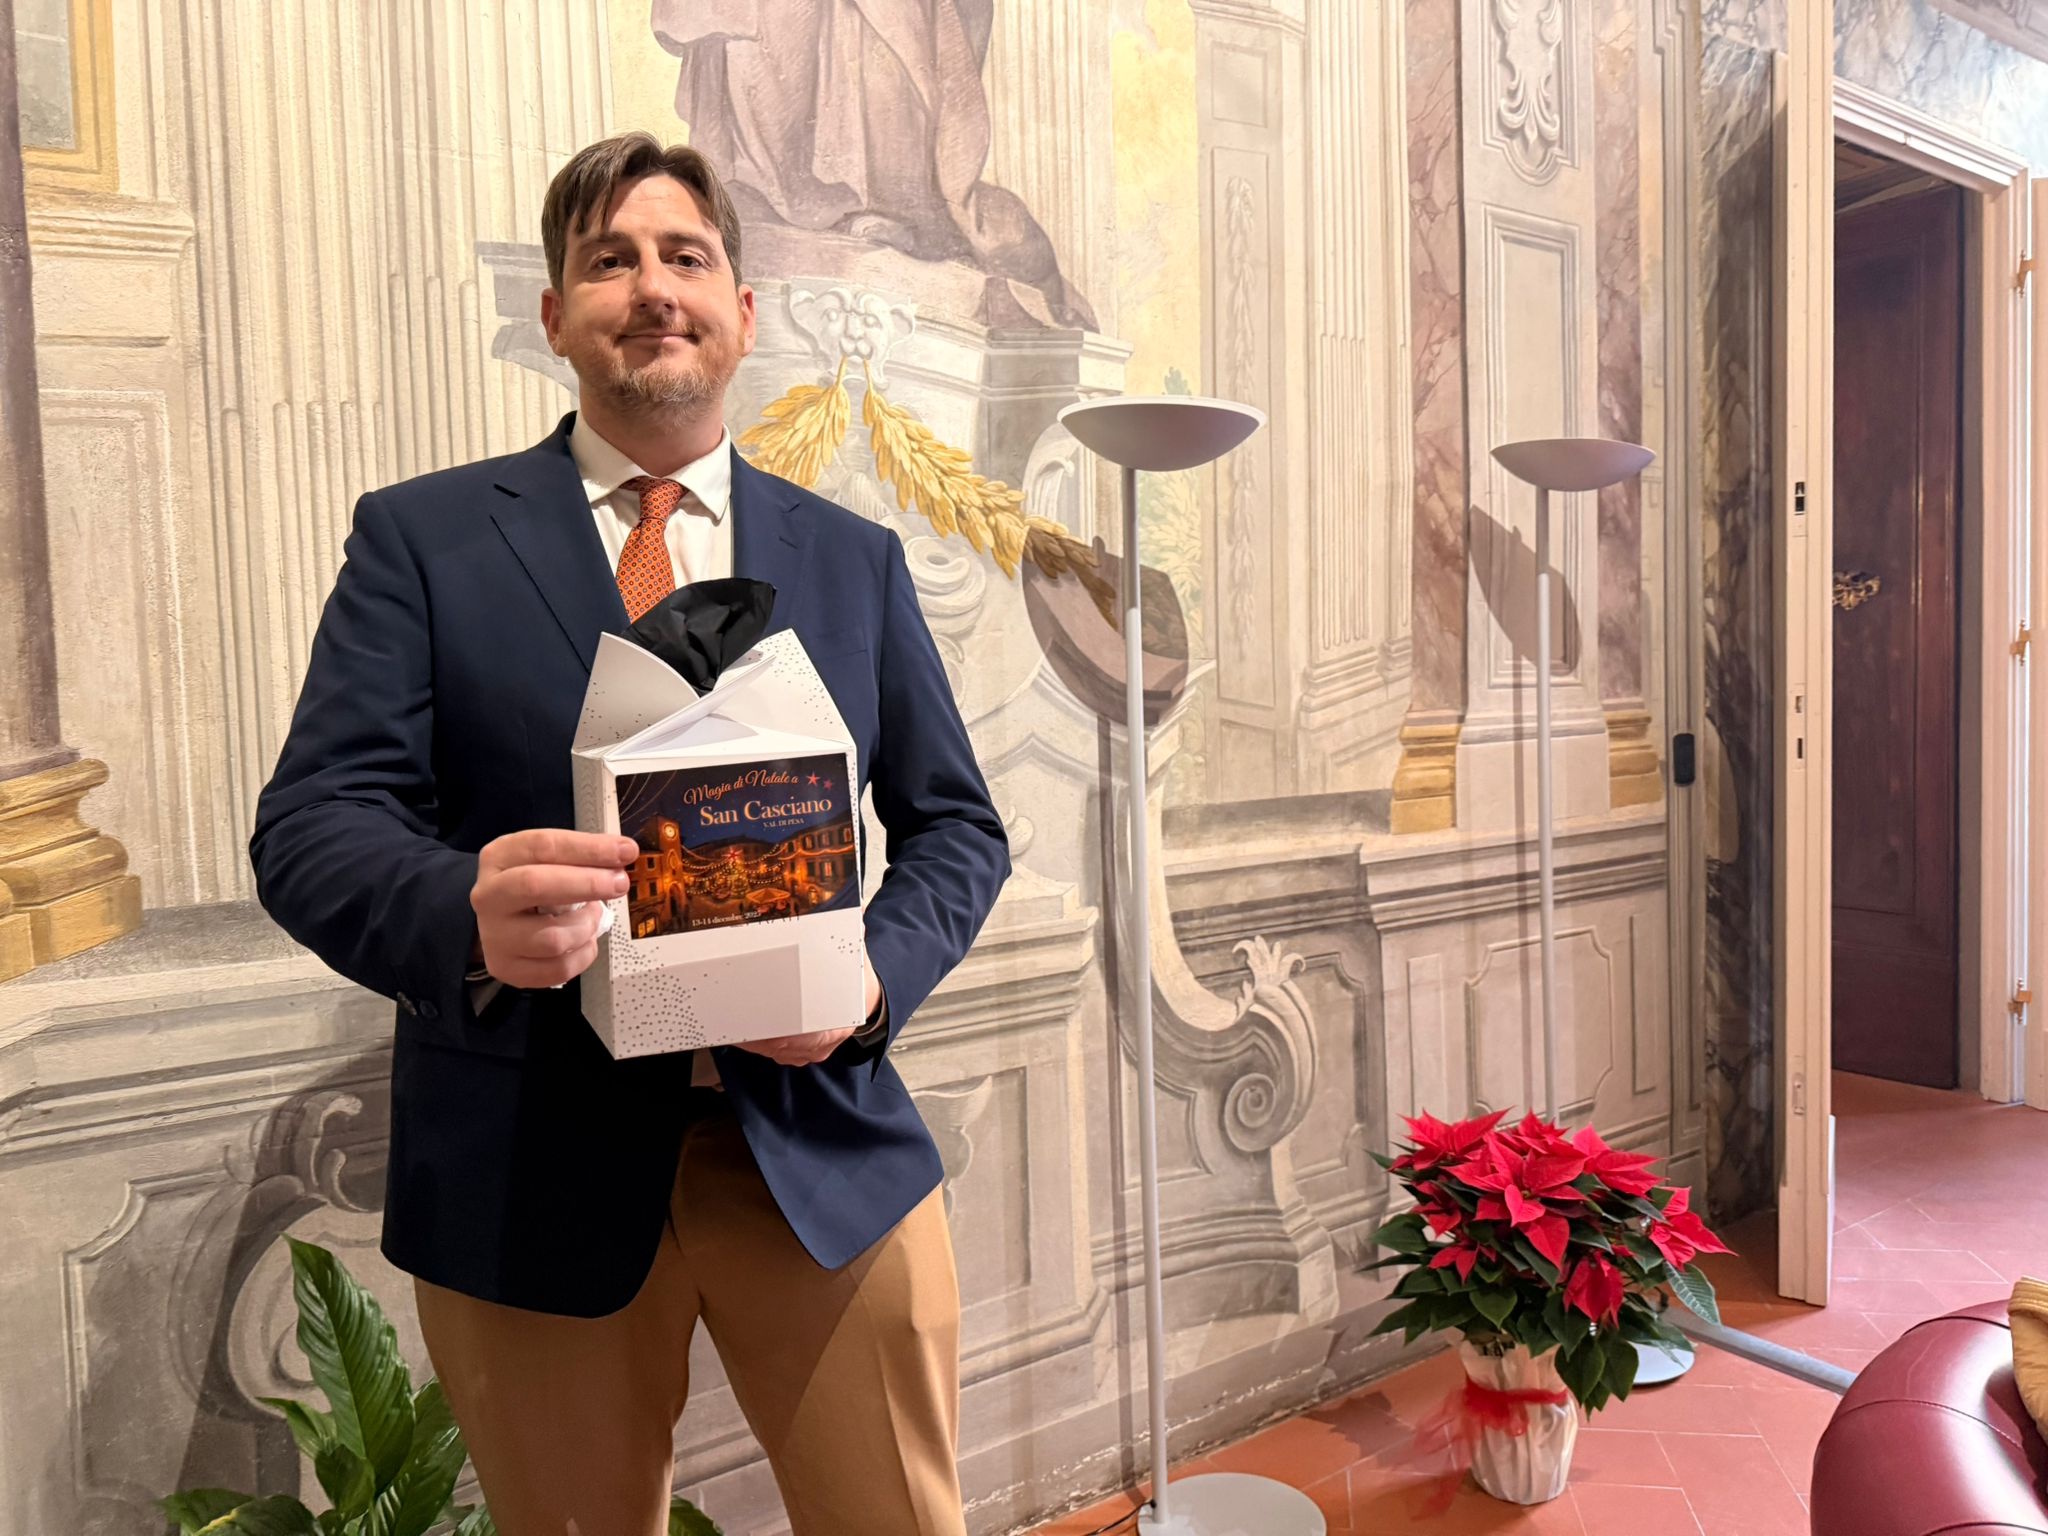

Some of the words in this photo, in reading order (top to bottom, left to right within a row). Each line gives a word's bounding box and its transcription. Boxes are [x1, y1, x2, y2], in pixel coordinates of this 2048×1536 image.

[683, 784, 731, 805] Magia
[733, 775, 744, 788] di
[745, 769, 789, 787] Natale
[791, 775, 799, 784] a
[700, 805, 739, 826] San
[743, 796, 833, 821] Casciano
[712, 913, 743, 924] dicembre
